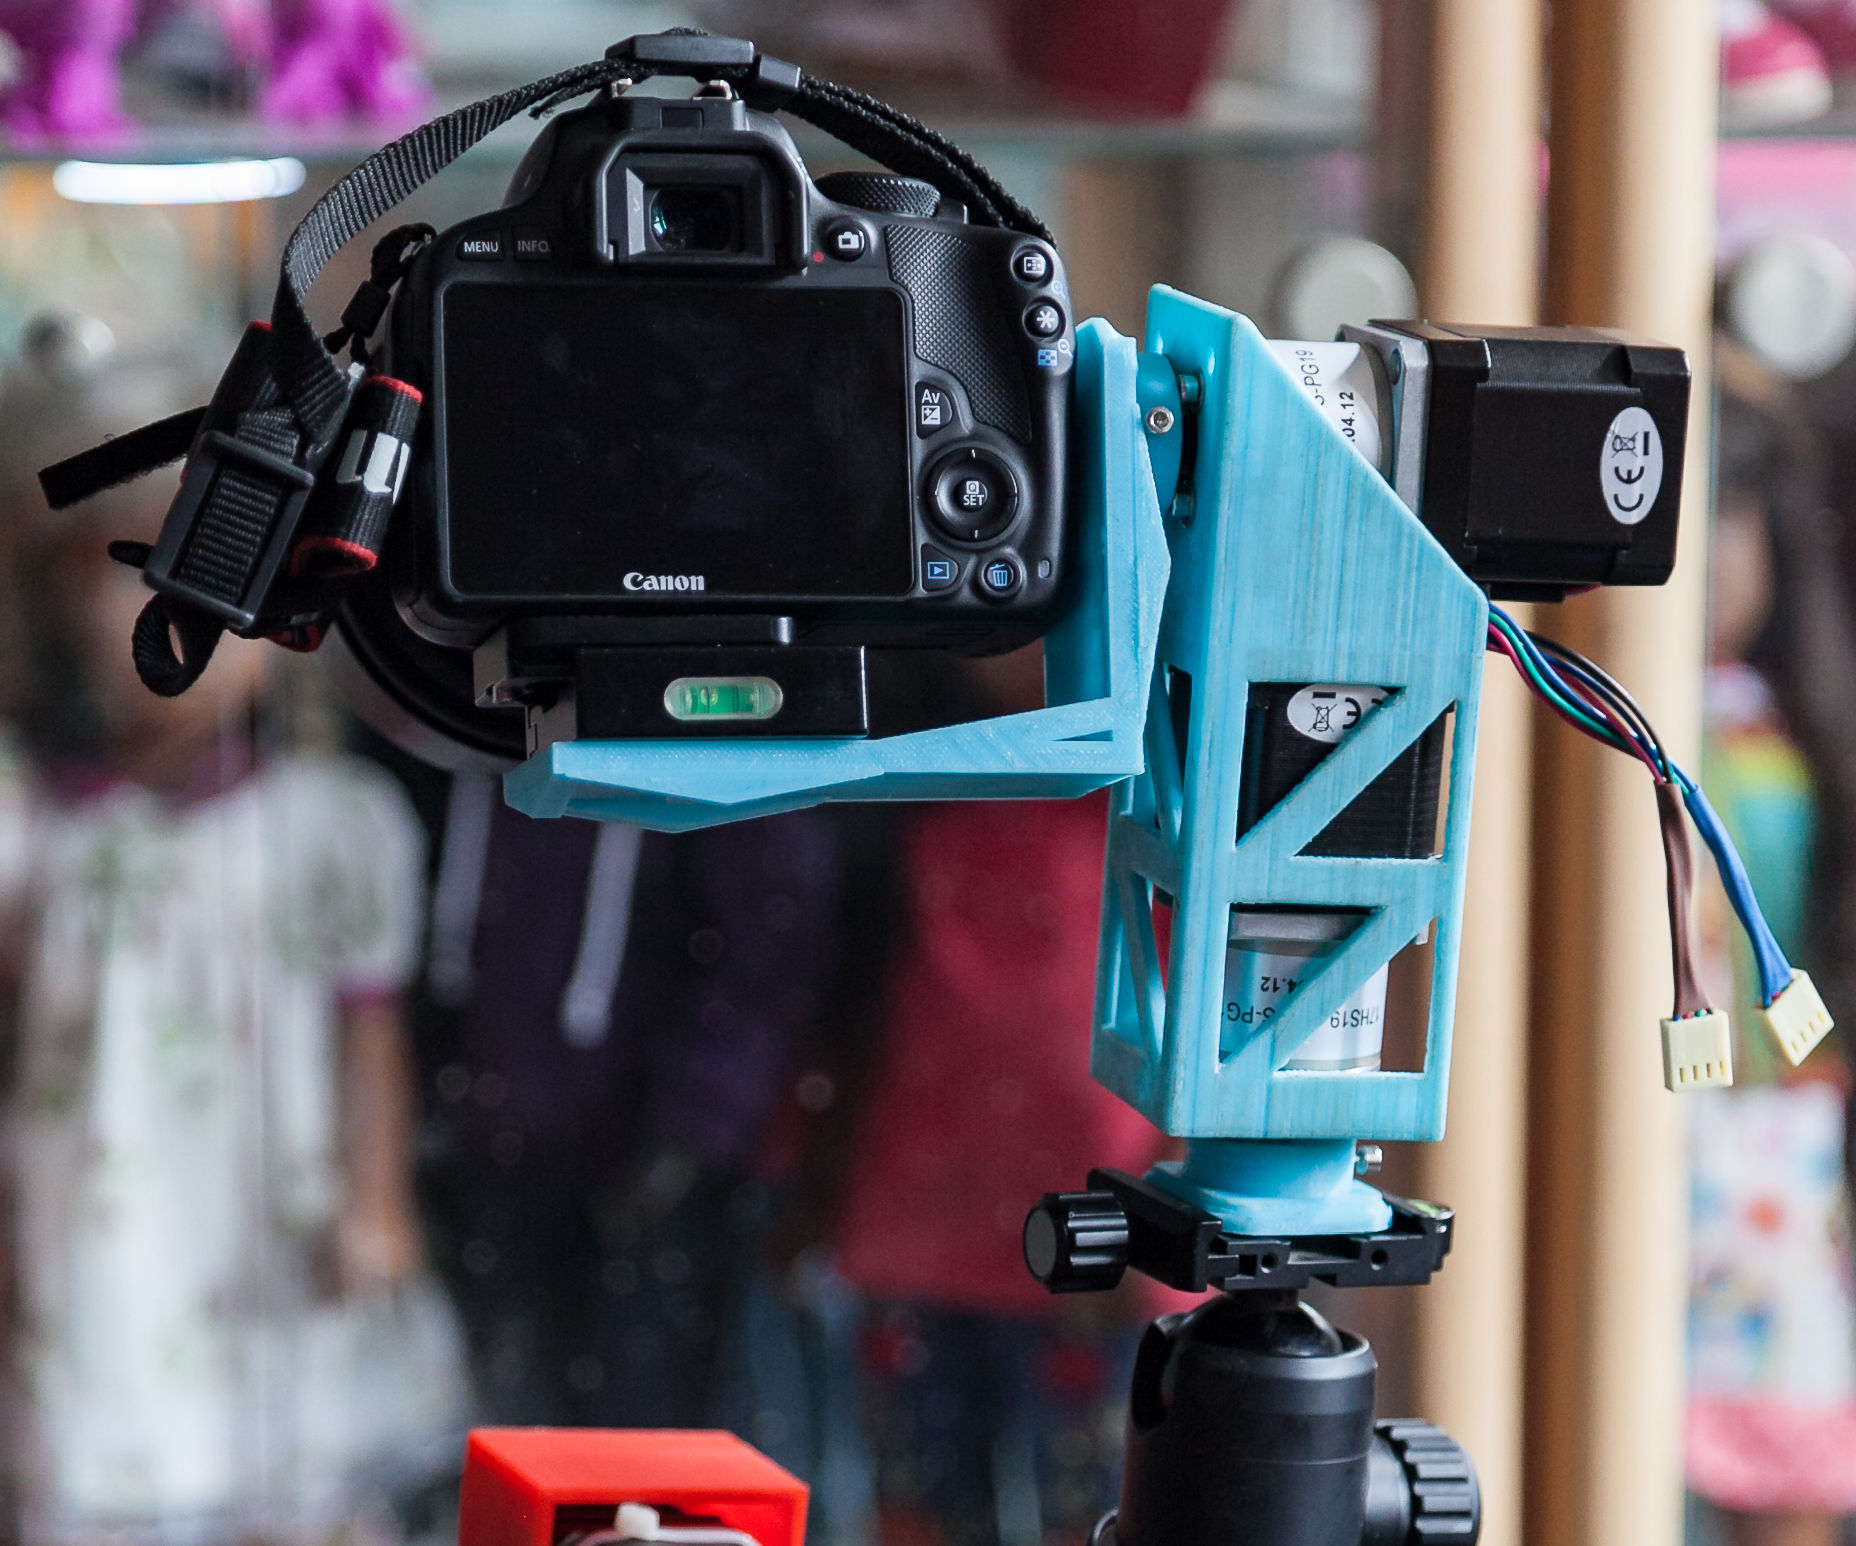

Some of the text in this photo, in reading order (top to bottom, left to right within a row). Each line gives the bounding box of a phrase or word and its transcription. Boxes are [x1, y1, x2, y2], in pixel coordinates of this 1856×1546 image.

[463, 241, 499, 253] MENU
[517, 240, 549, 252] INFO
[921, 388, 940, 404] Av
[963, 494, 984, 506] SET
[622, 572, 705, 591] Canon
[1260, 976, 1304, 995] 4.12
